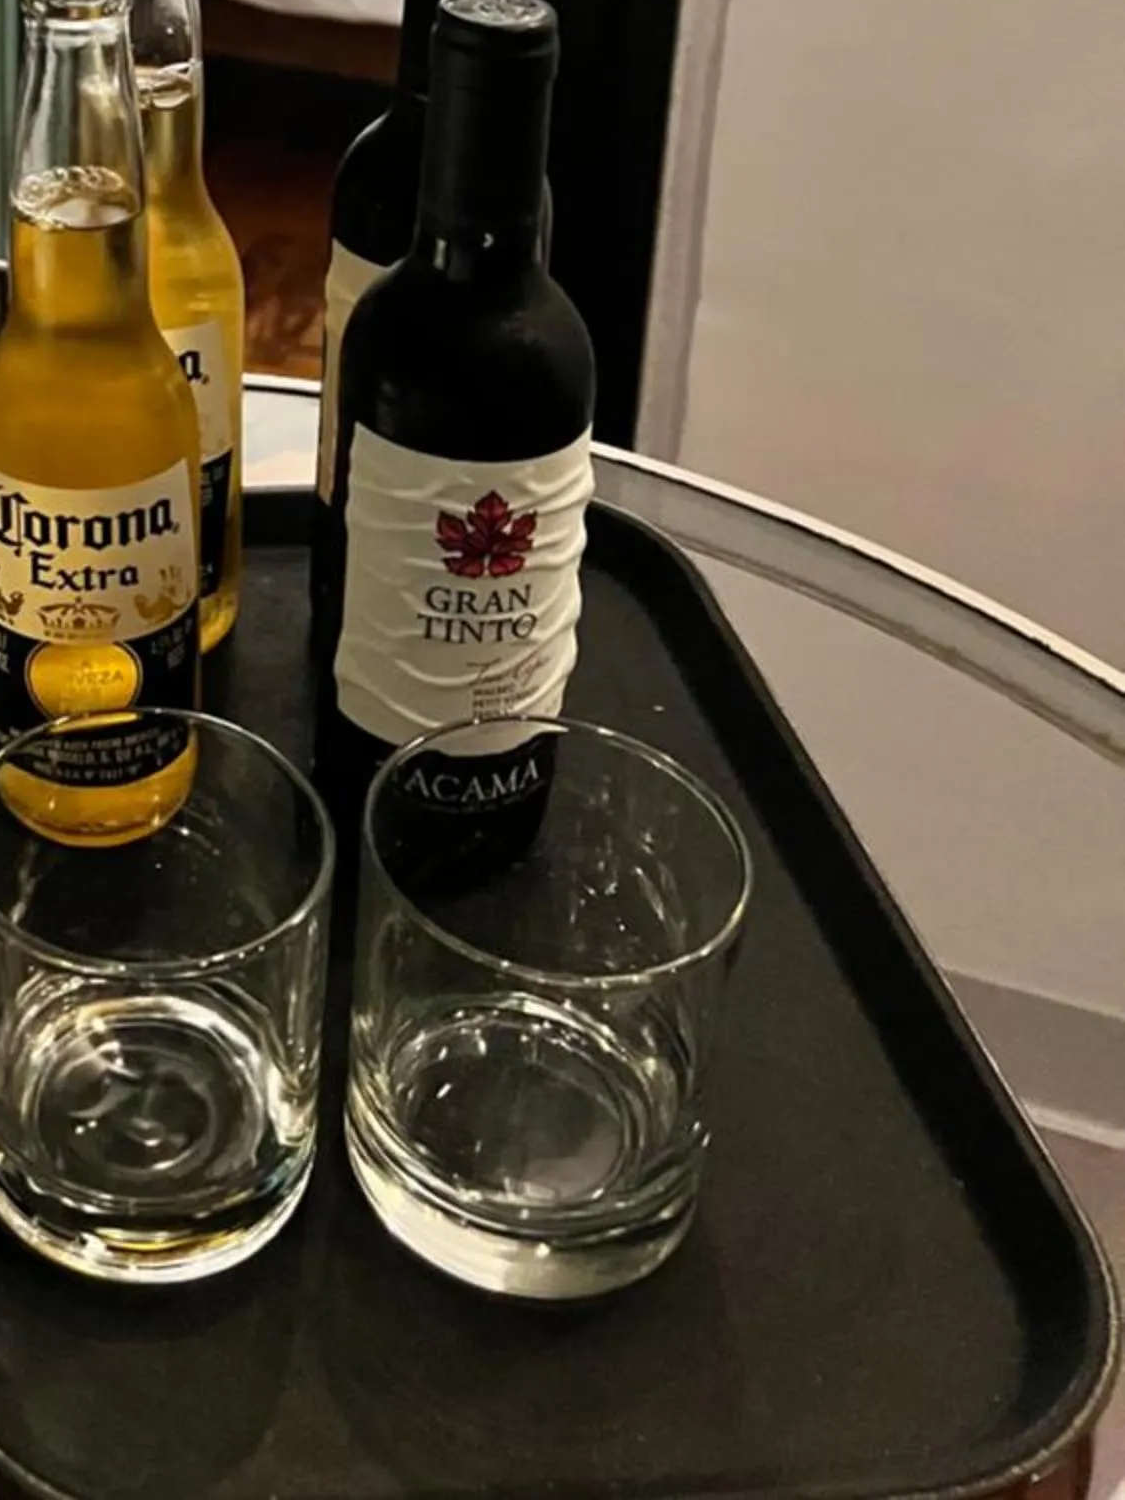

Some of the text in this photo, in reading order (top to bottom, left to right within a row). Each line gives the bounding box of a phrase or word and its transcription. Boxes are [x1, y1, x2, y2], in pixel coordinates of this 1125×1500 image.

[30, 549, 139, 592] Extra
[425, 584, 533, 616] GRAN
[417, 612, 538, 644] TINTO
